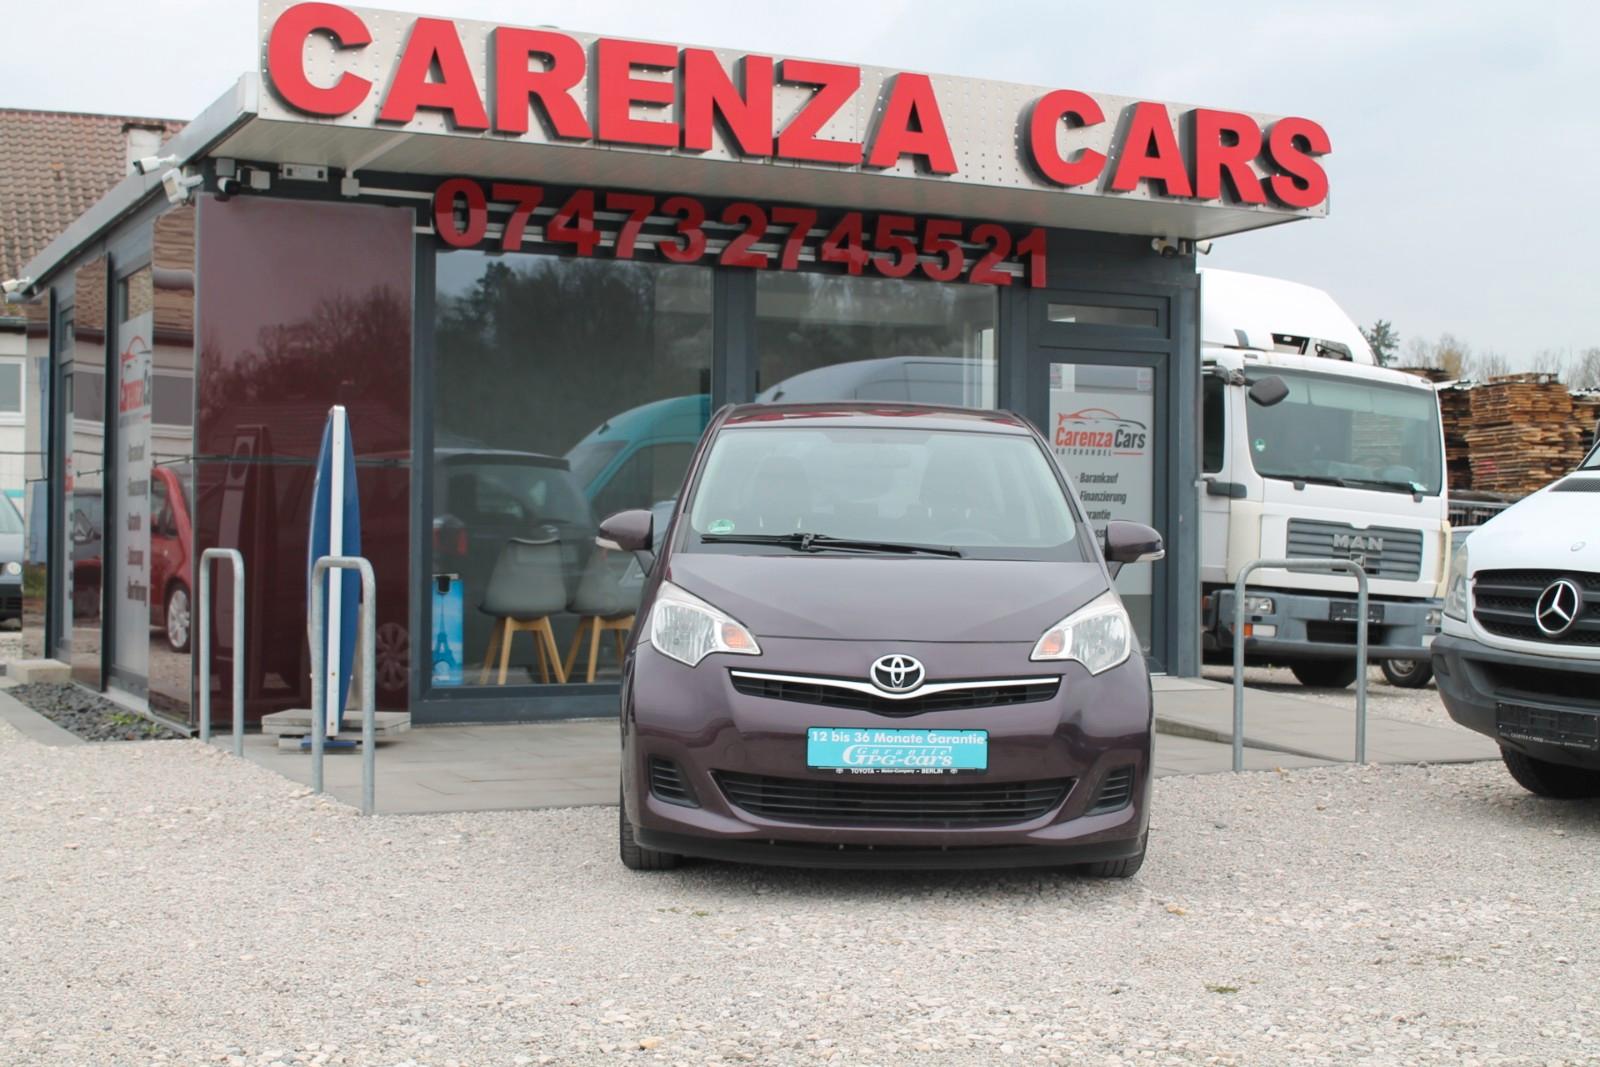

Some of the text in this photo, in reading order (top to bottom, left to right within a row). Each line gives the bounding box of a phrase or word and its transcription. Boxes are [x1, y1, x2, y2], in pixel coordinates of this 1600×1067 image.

[264, 1, 1332, 210] CARENZA CARS
[1055, 427, 1146, 449] Carenza Cars
[1080, 472, 1119, 484] Barankauf
[1080, 491, 1127, 505] Finanzierung
[1086, 509, 1111, 520] rantie
[1333, 534, 1383, 551] MAN
[812, 731, 985, 745] 12 bis 36 Monate Garantie
